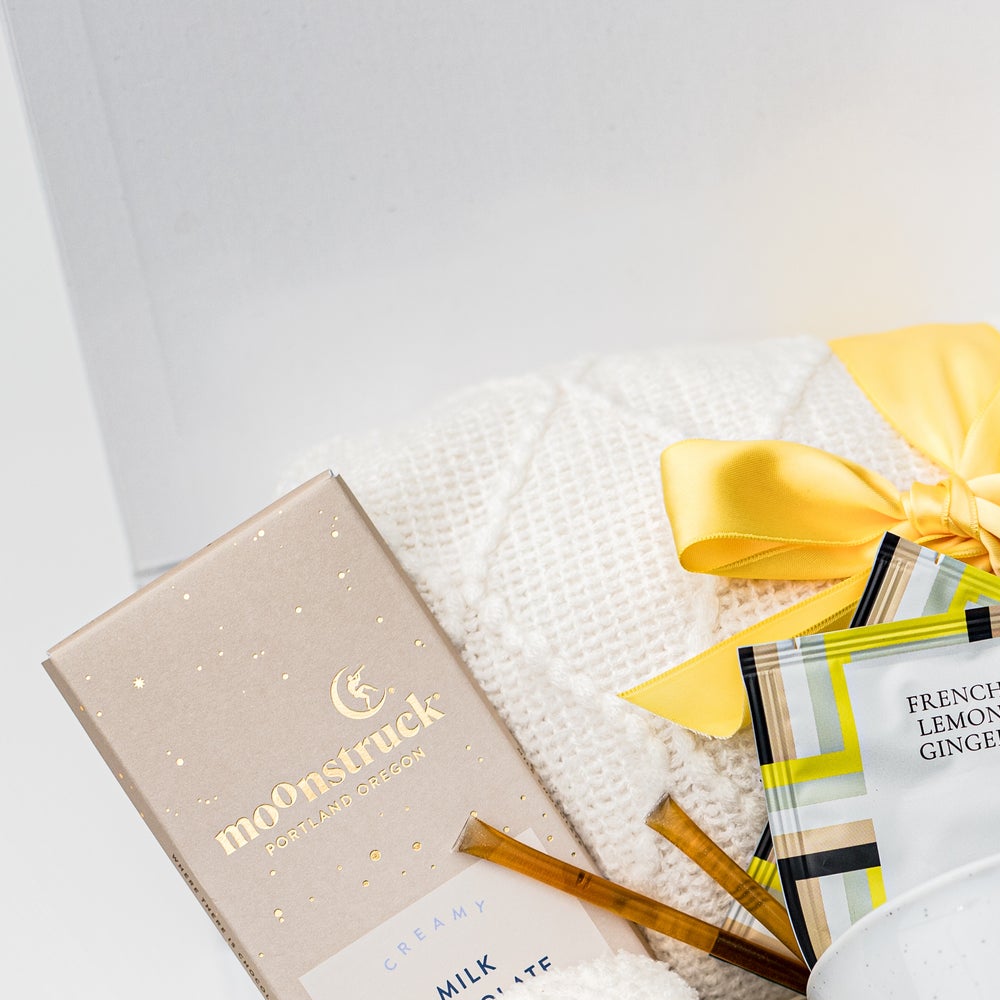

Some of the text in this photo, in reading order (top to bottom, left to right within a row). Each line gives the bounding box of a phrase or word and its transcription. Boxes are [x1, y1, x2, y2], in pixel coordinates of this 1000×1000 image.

[214, 692, 446, 855] moonstruck
[265, 746, 426, 856] PORTLAND OREGON
[384, 900, 485, 972] CREAMY
